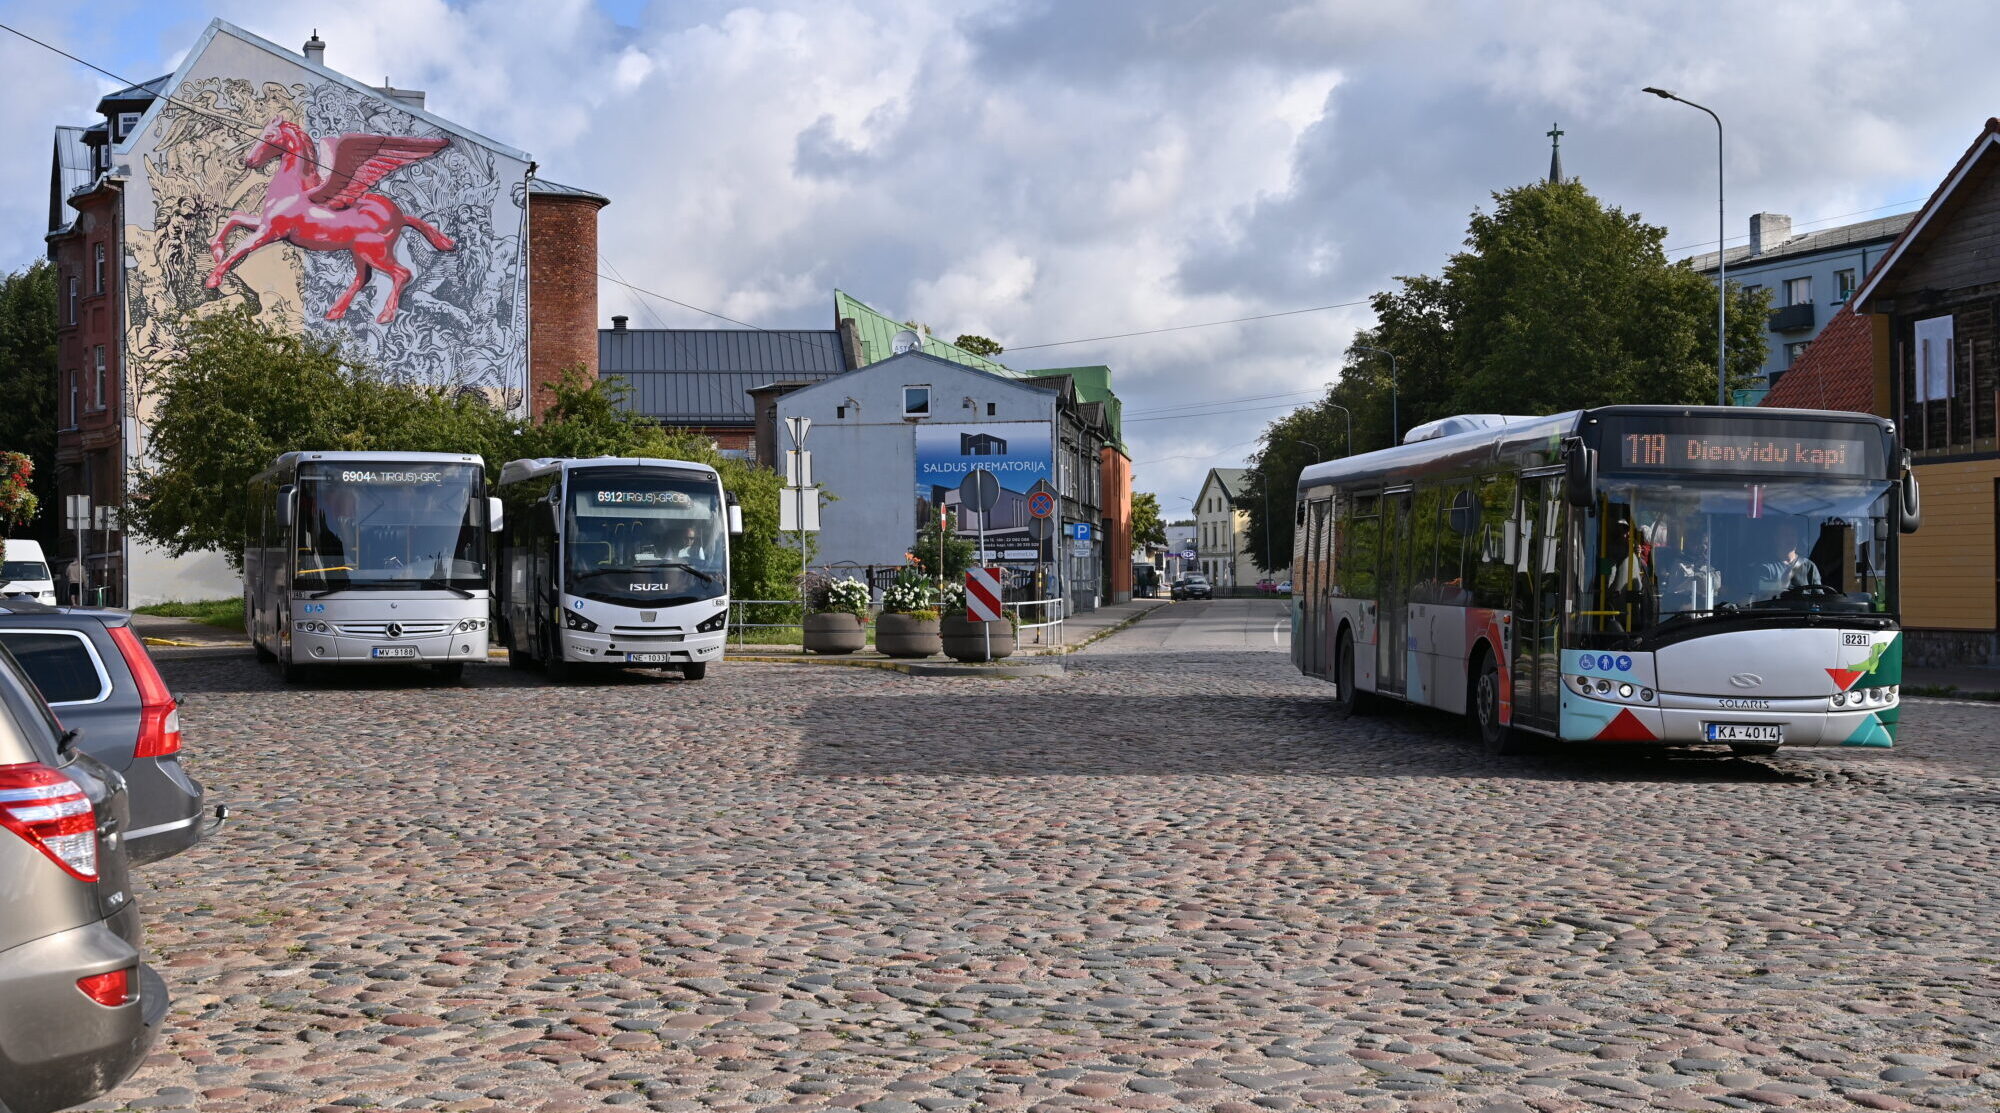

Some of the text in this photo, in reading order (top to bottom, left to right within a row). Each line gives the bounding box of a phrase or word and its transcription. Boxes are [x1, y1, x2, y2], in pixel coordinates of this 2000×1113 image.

[1626, 433, 1848, 470] 11A Dienvidu kapi
[923, 461, 1046, 473] SALDUS KREMATORIJA
[1077, 525, 1087, 539] P
[629, 583, 669, 592] ISUZU
[1845, 634, 1868, 645] 8231
[379, 648, 414, 656] MV-9188
[632, 654, 667, 662] NE-1033
[1718, 699, 1770, 710] SOLARIS
[1718, 726, 1777, 740] KA-4014
